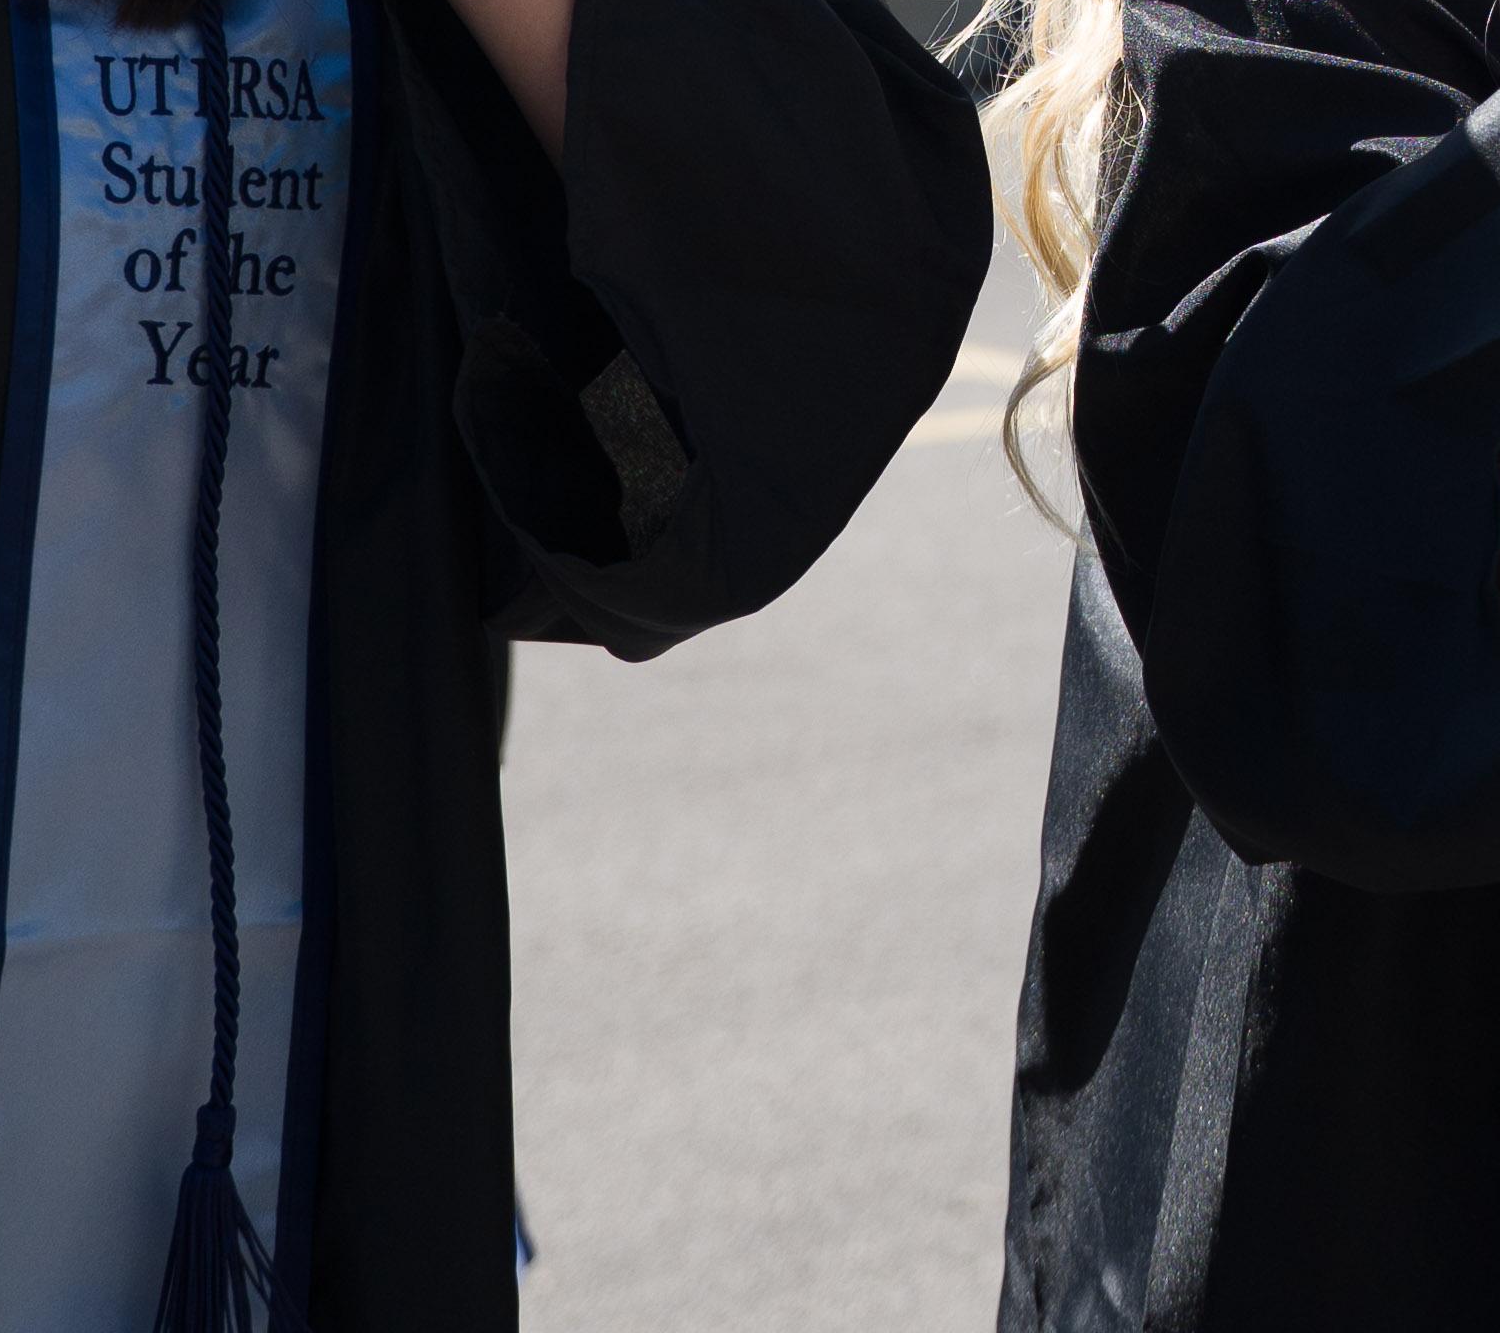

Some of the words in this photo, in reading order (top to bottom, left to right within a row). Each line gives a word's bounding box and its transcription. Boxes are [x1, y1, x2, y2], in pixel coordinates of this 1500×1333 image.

[94, 53, 180, 116] UT
[123, 228, 197, 293] of
[206, 231, 296, 297] he
